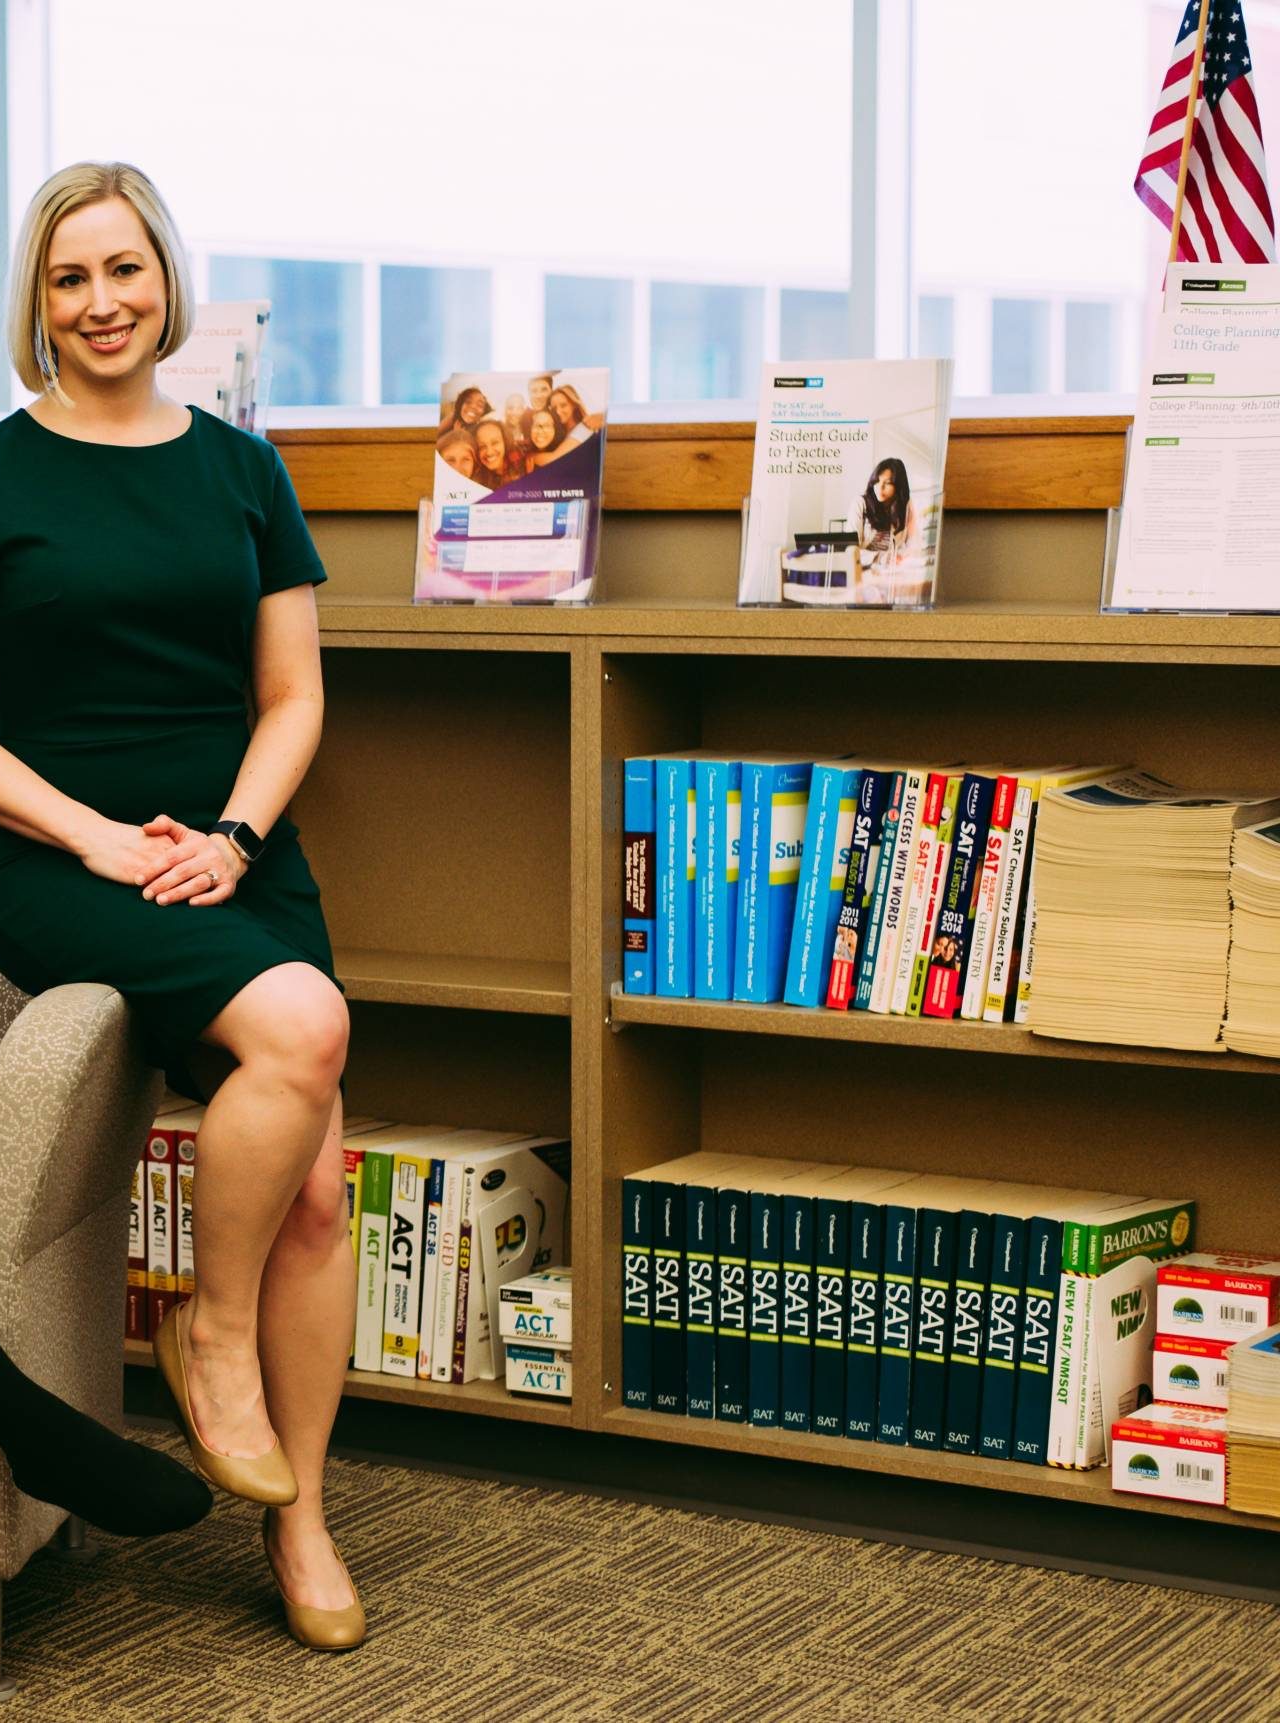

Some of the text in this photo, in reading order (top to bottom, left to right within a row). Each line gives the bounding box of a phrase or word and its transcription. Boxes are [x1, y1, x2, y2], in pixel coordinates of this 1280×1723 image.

[1173, 323, 1221, 337] College
[1173, 339, 1240, 352] 11th Grade
[1149, 401, 1186, 412] College
[769, 428, 868, 442] Student Guide
[769, 445, 841, 458] to Practice
[767, 461, 843, 474] and Scores
[865, 777, 874, 809] KAPLAN
[970, 782, 980, 815] KAPLAN
[818, 811, 827, 825] The
[816, 827, 825, 853] Official
[854, 814, 872, 851] SAT
[957, 820, 976, 858] SAT
[632, 842, 640, 867] Guide
[639, 839, 647, 856] The
[917, 840, 930, 869] SAT
[984, 836, 1002, 874] SAT
[625, 846, 633, 878] Subject
[812, 854, 821, 875] Study
[848, 851, 861, 885] BIOLOGY
[886, 795, 918, 929] SUCCESS WITH WORDS
[811, 876, 819, 899] Guide
[948, 873, 961, 910] HISTORY
[981, 875, 990, 895] TEST
[987, 876, 997, 912] SUBJECT
[638, 889, 646, 913] Study
[842, 906, 859, 917] 2011
[993, 828, 1024, 982] SAT Chemistry Subject Test
[839, 915, 859, 927] 2012
[940, 921, 961, 935] 2014
[942, 910, 964, 924] 2013
[898, 906, 918, 979] BIOLOGY E/M
[970, 911, 989, 981] CHEMISTRY
[802, 945, 810, 972] Subject
[154, 1204, 166, 1236] ACT
[367, 1227, 380, 1259] ACT
[391, 1212, 414, 1280] ACT
[427, 1212, 437, 1256] ACT 36
[1072, 1228, 1080, 1266] BARRON'S
[1102, 1219, 1169, 1255] BARRON'S
[439, 1232, 455, 1337] GED Mathematics
[456, 1236, 471, 1334] GED Mathematics
[625, 1254, 649, 1317] SAT
[655, 1257, 679, 1321] SAT
[688, 1261, 712, 1325] SAT
[720, 1264, 745, 1329] SAT
[1224, 1279, 1263, 1292] BARRON'S
[393, 1283, 401, 1318] EDITION
[752, 1269, 778, 1334] SAT
[784, 1271, 810, 1336] SAT
[817, 1275, 844, 1340] SAT
[850, 1279, 876, 1345] SAT
[1084, 1282, 1093, 1318] Strategies
[1110, 1288, 1142, 1318] NEW
[514, 1313, 554, 1333] ACT
[884, 1282, 911, 1349] SAT
[918, 1287, 947, 1354] SAT
[953, 1289, 982, 1356] SAT
[988, 1293, 1017, 1360] SAT
[1172, 1309, 1204, 1320] BARRON'S
[395, 1335, 404, 1347] 8
[516, 1330, 558, 1340] VOCABULARY
[1023, 1296, 1052, 1364] SAT
[1056, 1279, 1076, 1405] NEW PSAT/NMSQT
[1082, 1333, 1090, 1361] Practice
[522, 1370, 566, 1391] ACT
[524, 1363, 566, 1373] ESSENTIAL
[1169, 1376, 1200, 1386] BARRON'S
[627, 1390, 647, 1402] SAT
[657, 1394, 677, 1406] SAT
[690, 1399, 711, 1410] SAT
[721, 1403, 743, 1415] SAT
[752, 1408, 774, 1420] SAT
[784, 1411, 805, 1423] SAT
[816, 1416, 838, 1427] SAT
[849, 1420, 871, 1432] SAT
[1076, 1404, 1086, 1449] PSAT/NMSQT
[881, 1424, 903, 1437] SAT
[914, 1429, 936, 1442] SAT
[948, 1432, 970, 1445] SAT
[983, 1436, 1005, 1449] SAT
[1178, 1436, 1218, 1450] BARRON'S
[1017, 1441, 1039, 1454] SAT
[1128, 1466, 1159, 1477] BARRON'S
